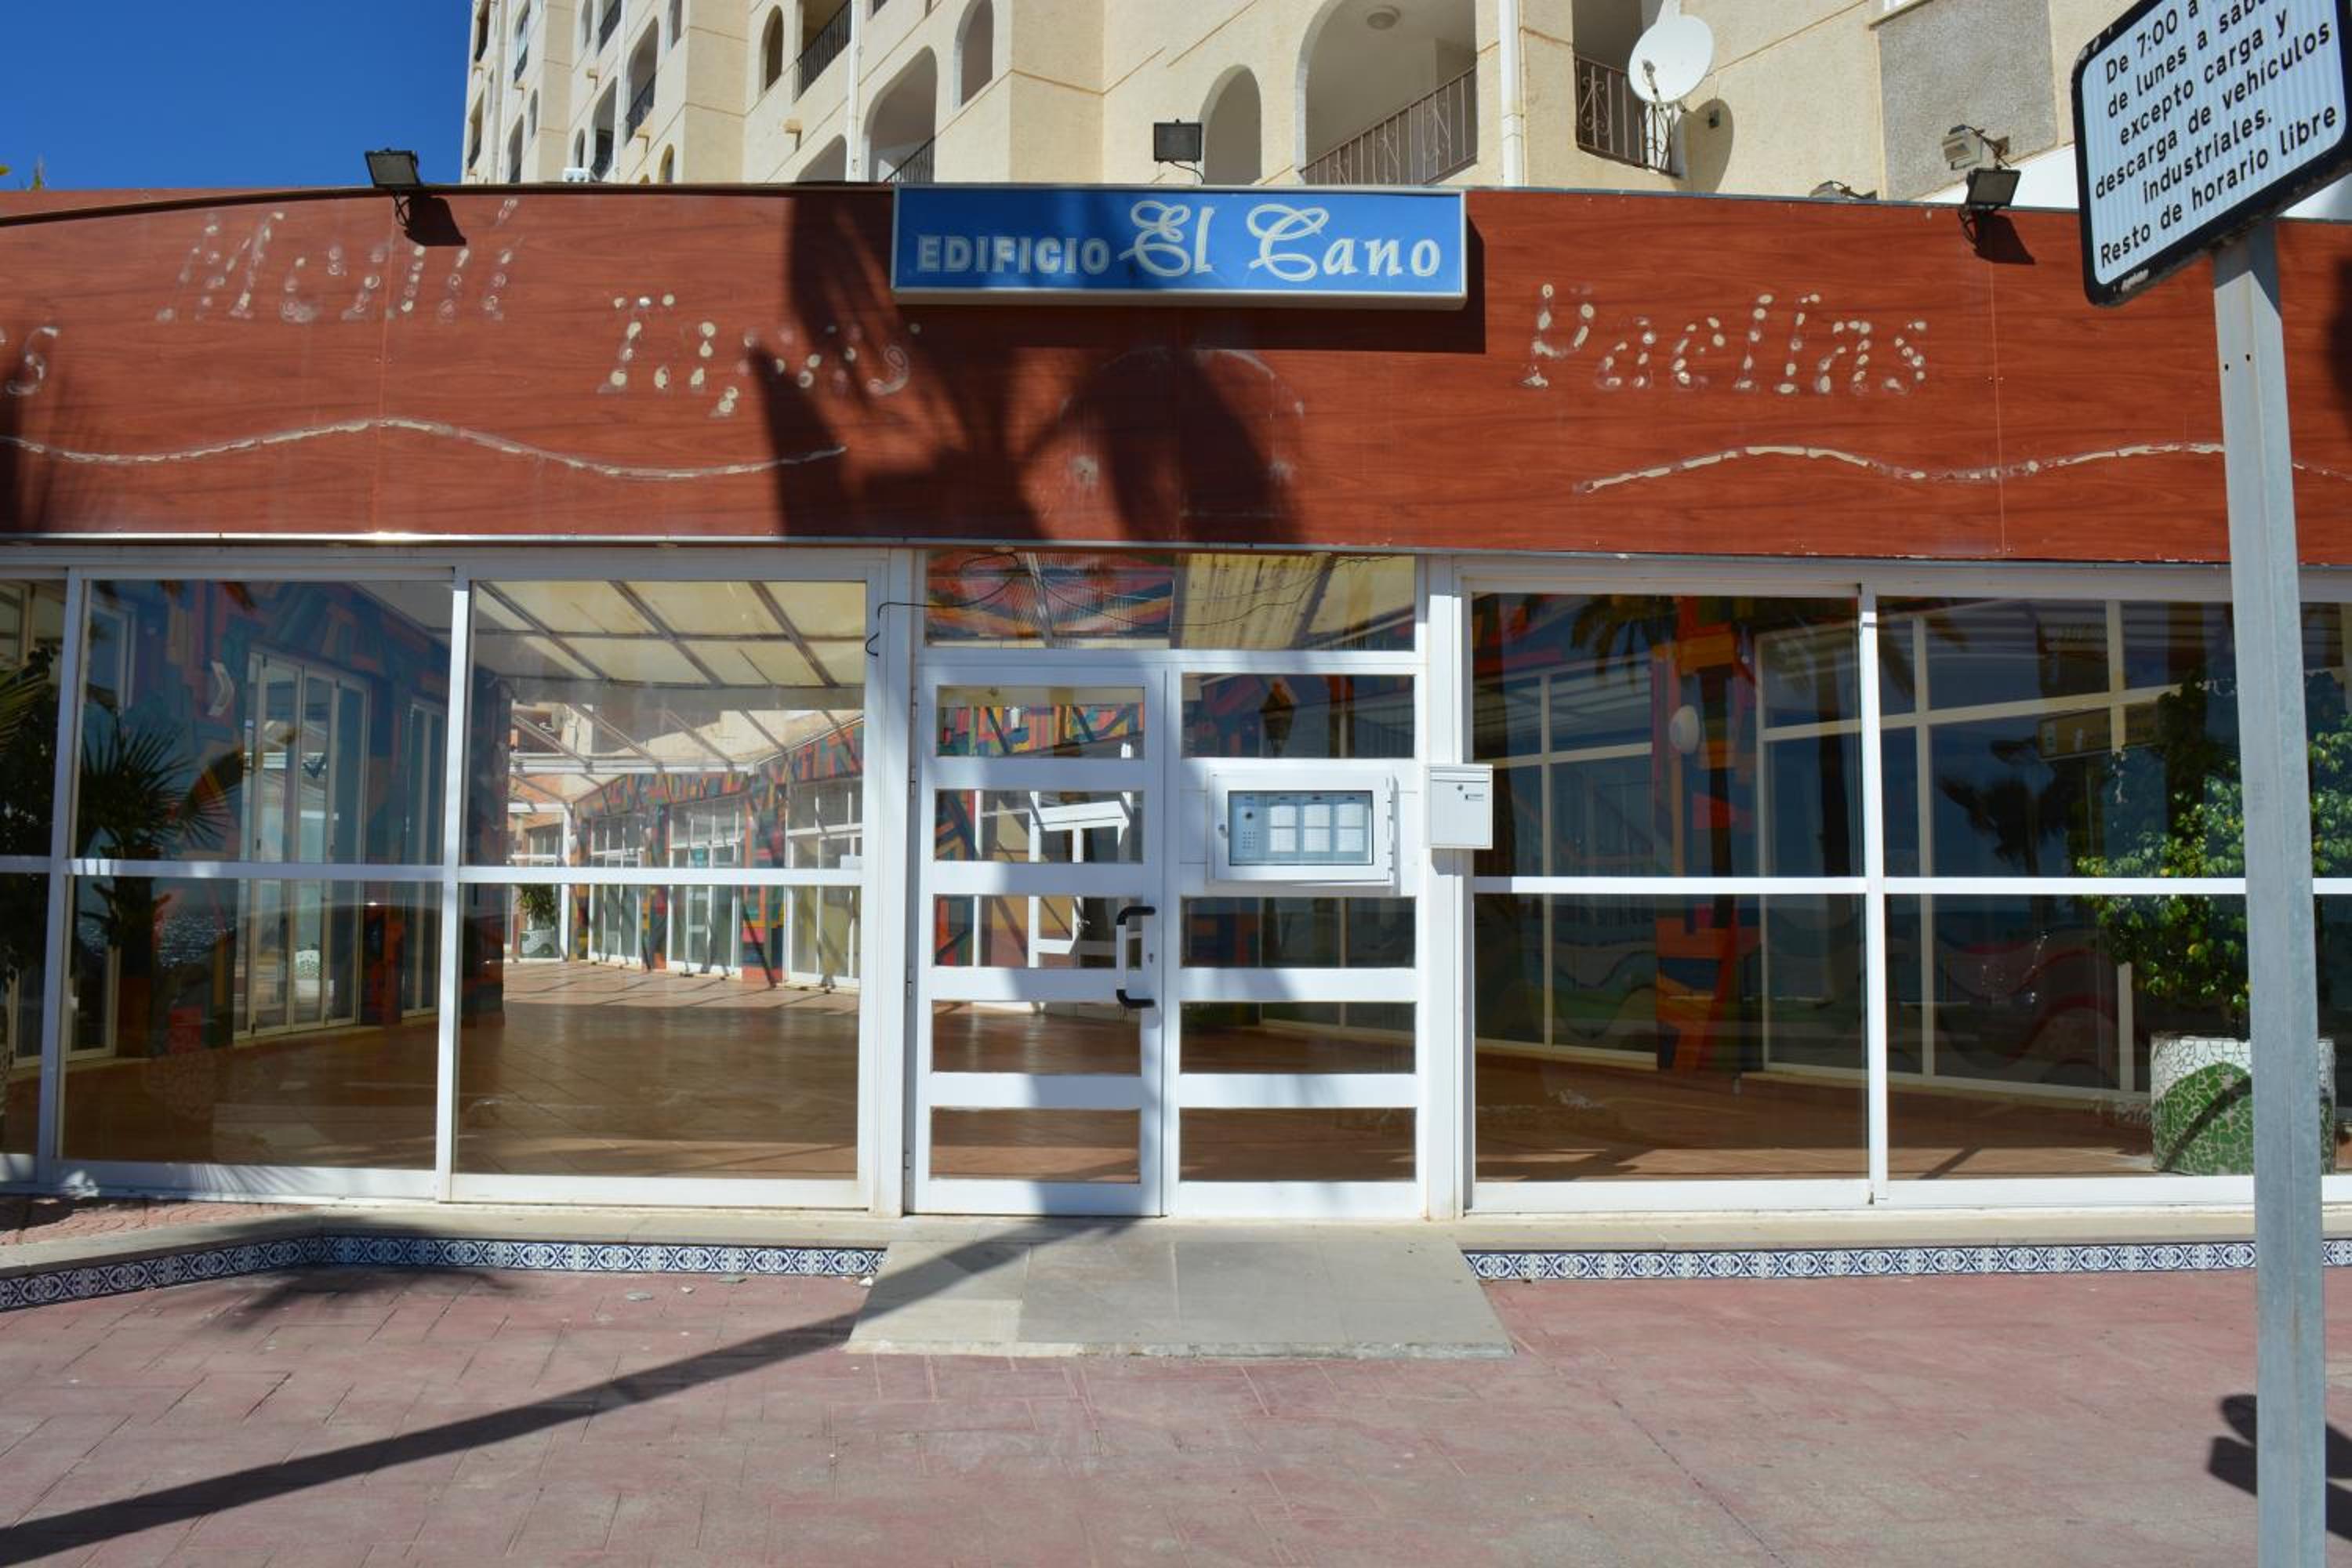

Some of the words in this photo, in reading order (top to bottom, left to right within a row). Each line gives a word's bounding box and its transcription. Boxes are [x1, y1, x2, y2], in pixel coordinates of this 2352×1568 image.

[2106, 54, 2129, 85] De
[2136, 9, 2178, 58] 7:00
[2107, 91, 2129, 118] de
[2136, 45, 2187, 97] lunes
[2197, 30, 2209, 51] a
[2120, 79, 2194, 146] excepto
[2204, 28, 2264, 85] carga
[2275, 9, 2287, 39] y
[2096, 129, 2178, 199] descarga
[2188, 106, 2211, 135] de
[2100, 223, 2151, 268] Resto
[2160, 203, 2183, 230] de
[2191, 148, 2269, 211] horario
[2279, 106, 2336, 156] libre
[2143, 109, 2272, 205] industriales.
[916, 235, 1110, 274] EDIFICIO
[1116, 200, 1214, 277] El
[1246, 202, 1441, 282] Cano
